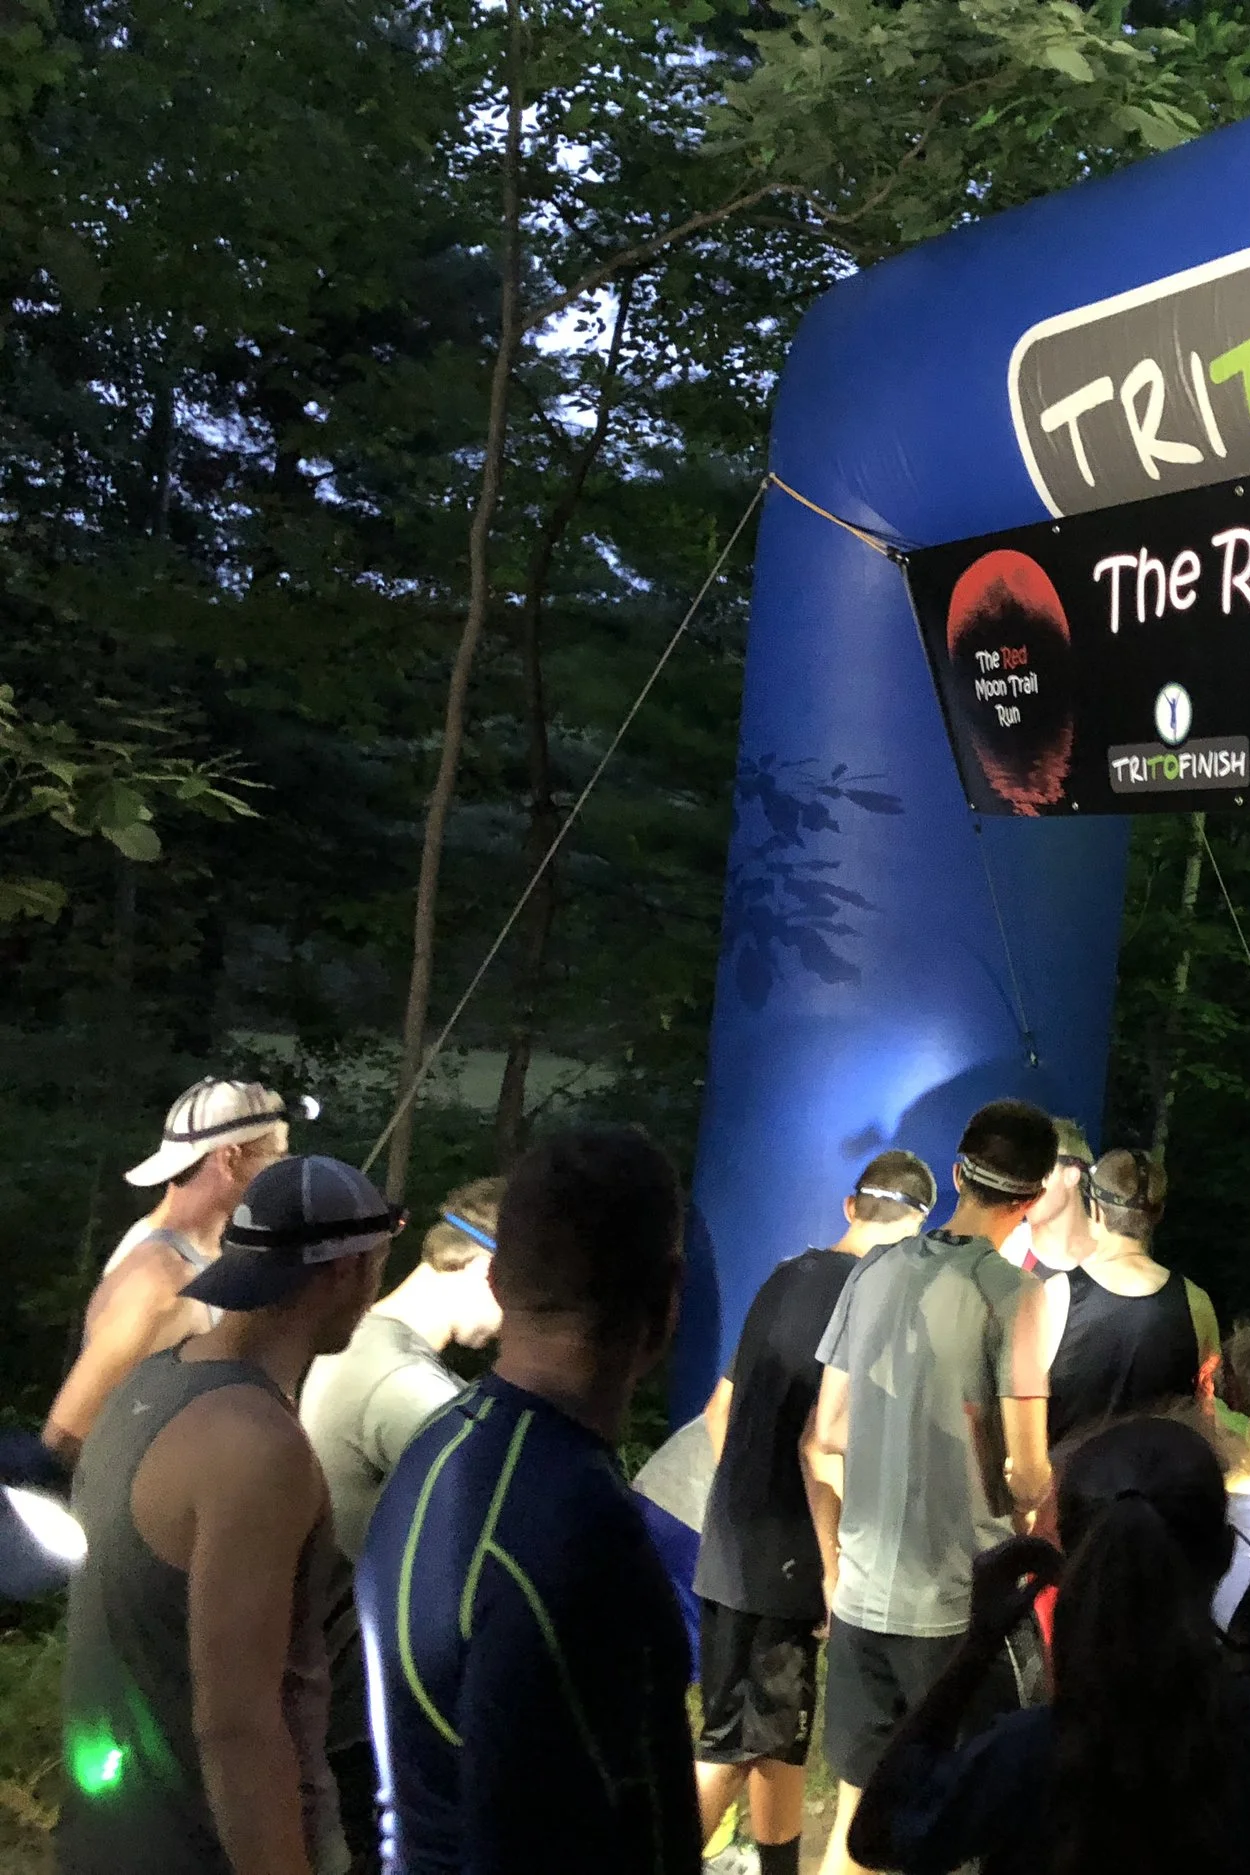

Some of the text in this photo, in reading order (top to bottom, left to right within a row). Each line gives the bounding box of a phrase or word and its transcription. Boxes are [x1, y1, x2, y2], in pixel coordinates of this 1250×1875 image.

[1094, 547, 1200, 633] The
[975, 644, 1027, 673] The Red
[975, 671, 1038, 701] Moon Trail
[994, 704, 1021, 727] Run
[1112, 749, 1246, 784] TRITOFINISH
